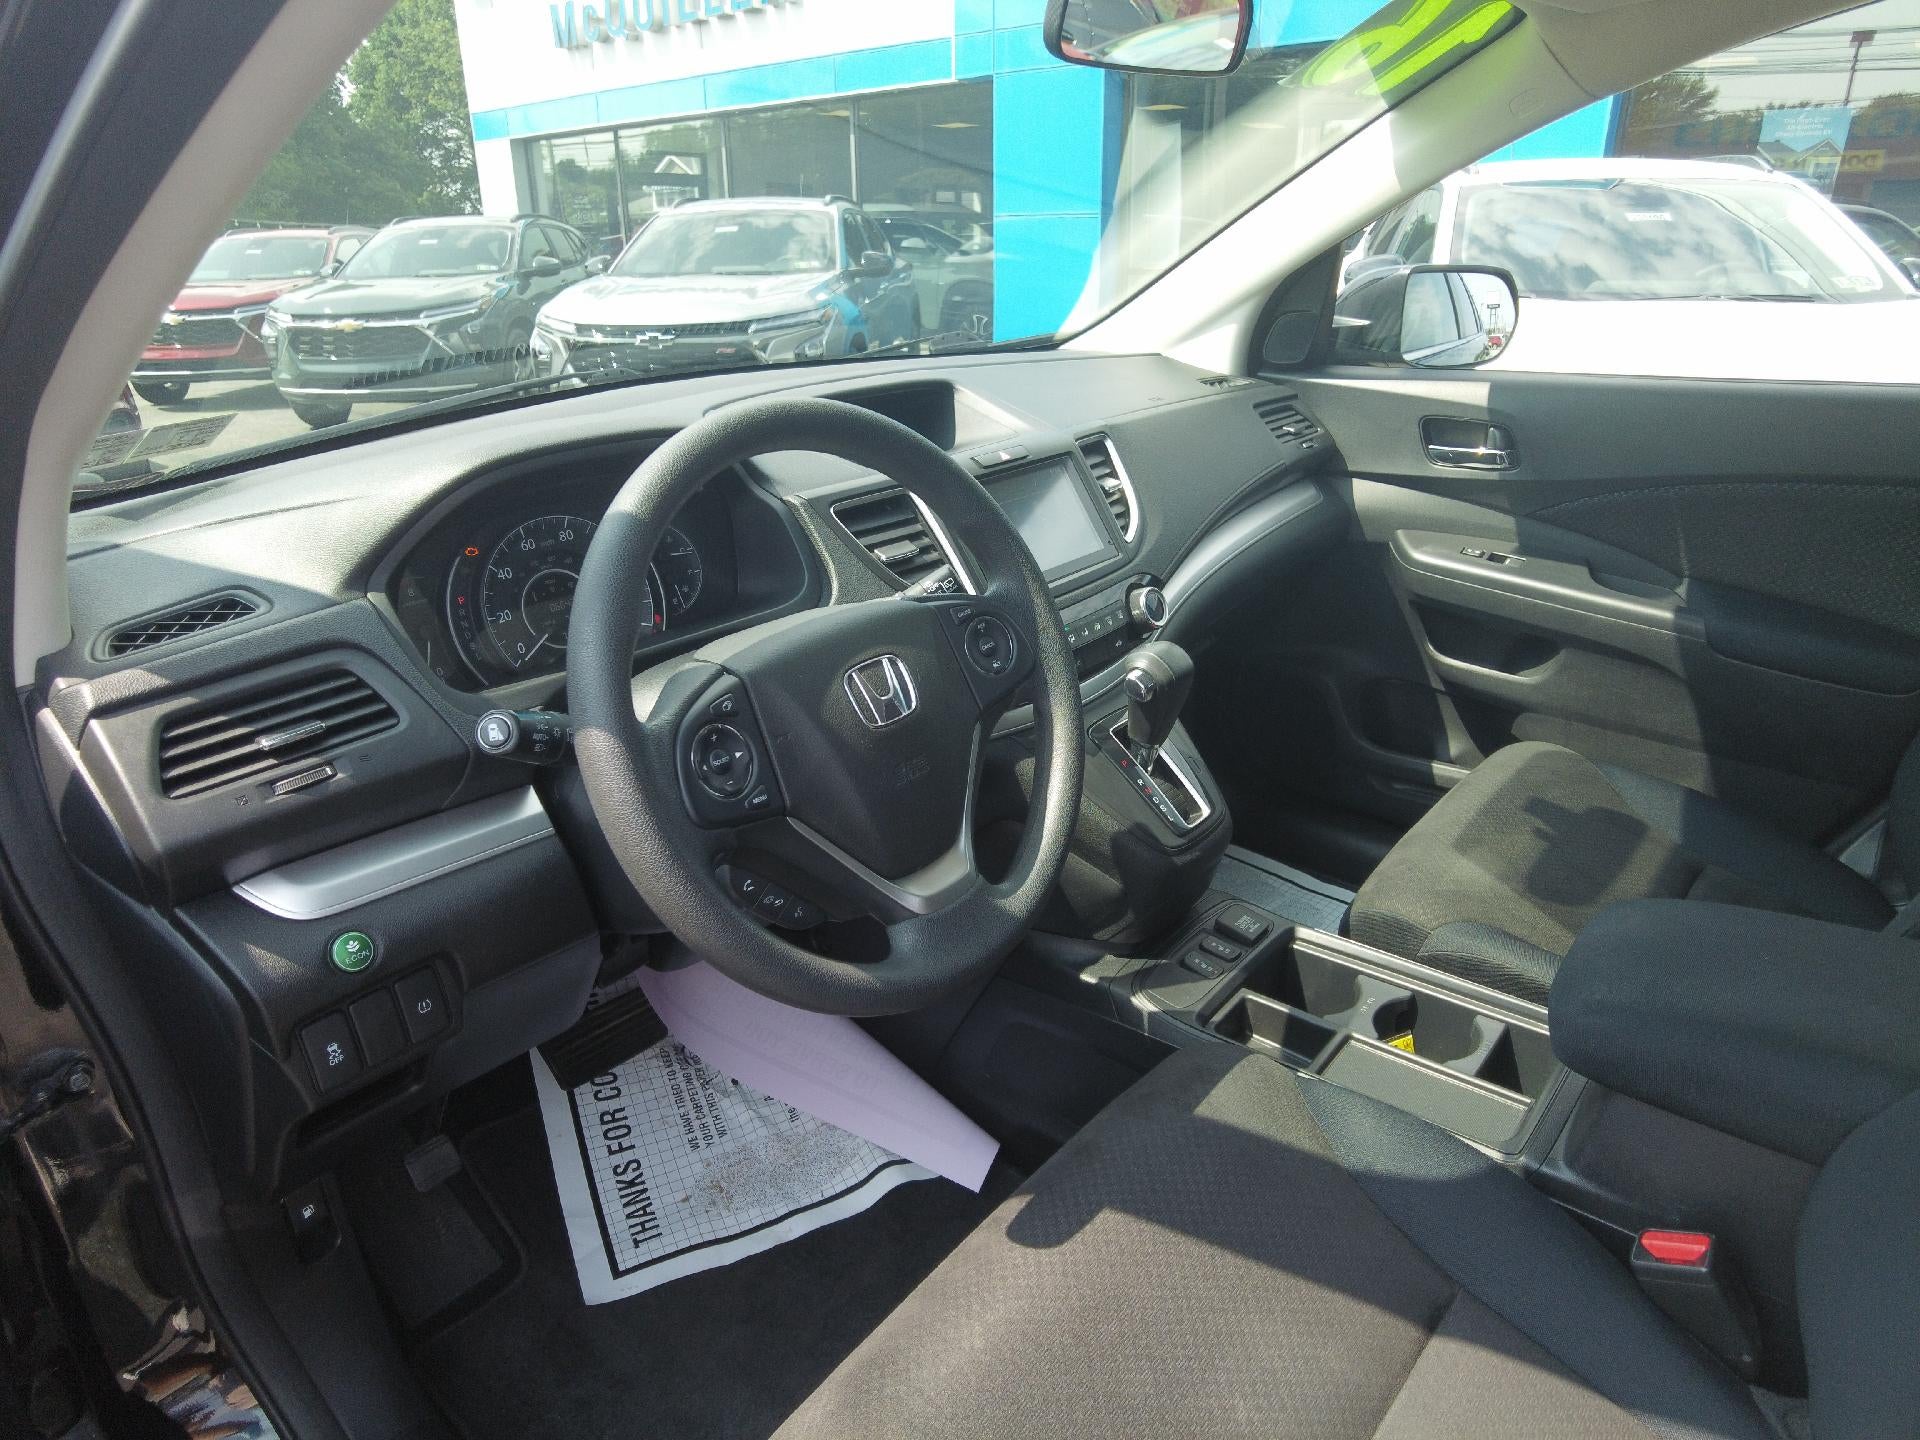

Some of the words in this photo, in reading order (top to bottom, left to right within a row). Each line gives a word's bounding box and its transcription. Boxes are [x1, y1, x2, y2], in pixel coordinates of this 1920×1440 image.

[559, 529, 574, 543] 80
[520, 538, 536, 551] 60
[497, 567, 513, 580] 40
[457, 595, 465, 604] P
[497, 609, 513, 624] 20
[517, 642, 526, 655] 0
[1152, 796, 1160, 804] D
[1159, 804, 1167, 812] S
[345, 949, 370, 965] ECON
[329, 1054, 345, 1066] OFF
[659, 1047, 674, 1069] KEEP
[666, 1069, 679, 1083] TO
[671, 1083, 686, 1111] TRIED
[682, 1072, 706, 1121] CARPETING
[704, 1092, 719, 1114] THIS
[600, 1106, 636, 1156] FOR
[679, 1111, 696, 1135] HAVE
[711, 1114, 728, 1140] WITH
[687, 1135, 701, 1152] WE
[698, 1121, 716, 1150] YOUR
[612, 1158, 663, 1249] THANKS
